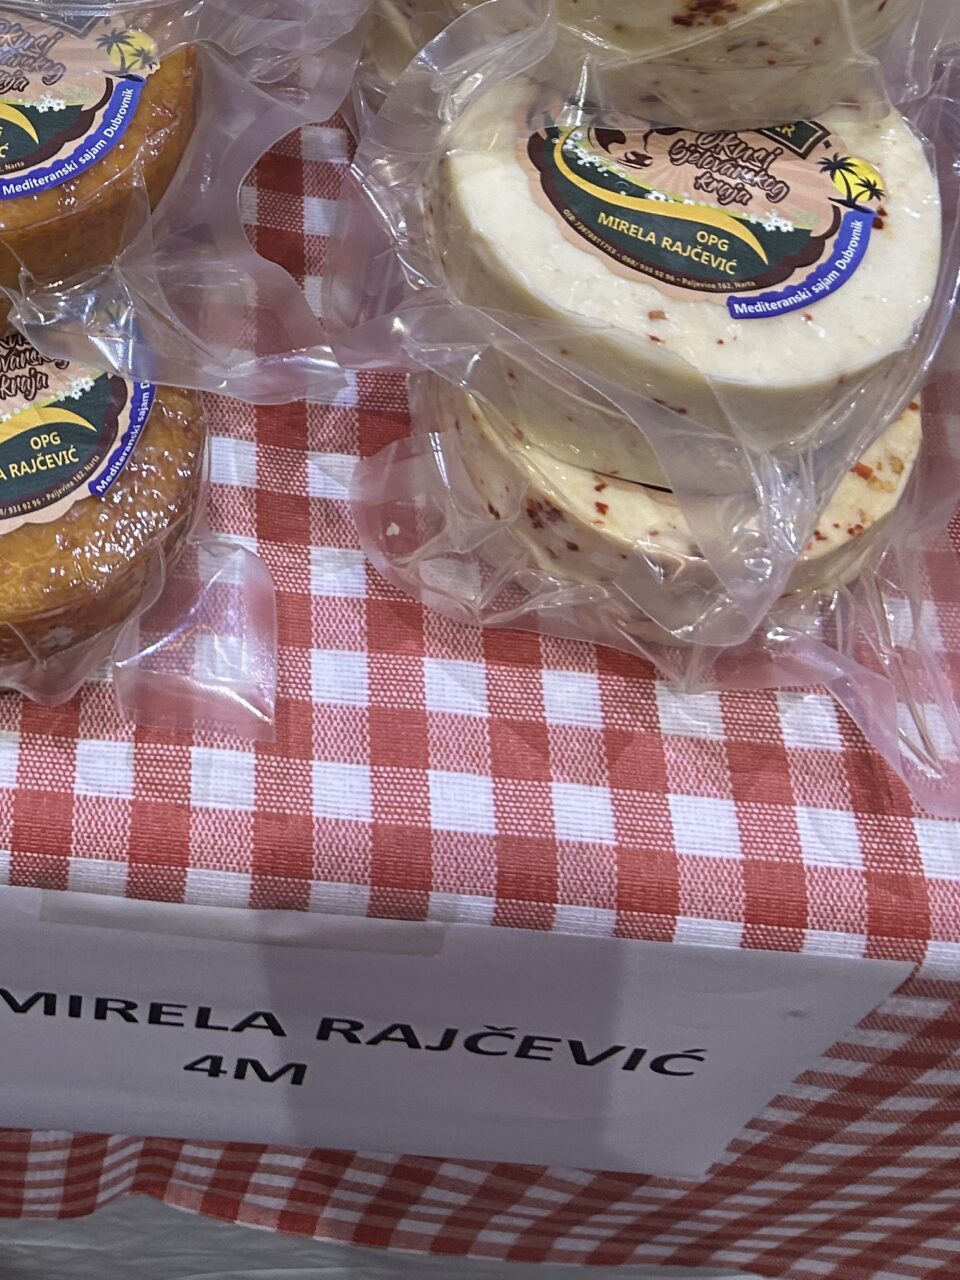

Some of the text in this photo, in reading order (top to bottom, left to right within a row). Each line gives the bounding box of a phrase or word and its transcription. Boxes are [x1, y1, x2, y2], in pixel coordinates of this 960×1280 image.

[2, 88, 134, 196] Mediteranski sajam Dubrovnik
[696, 131, 784, 169] Okusi
[694, 171, 753, 206] kraja
[597, 212, 738, 275] MIRELA RAJČEVIĆ
[696, 230, 730, 252] OPG
[733, 219, 864, 314] Mediteranski sajam Dubrovnik
[30, 431, 61, 450] OPG
[95, 391, 150, 493] Mediteranski sajam
[8, 444, 79, 478] RAJČEVIĆ
[315, 1016, 708, 1077] RAJČEVIĆ
[183, 1054, 308, 1086] 4M
